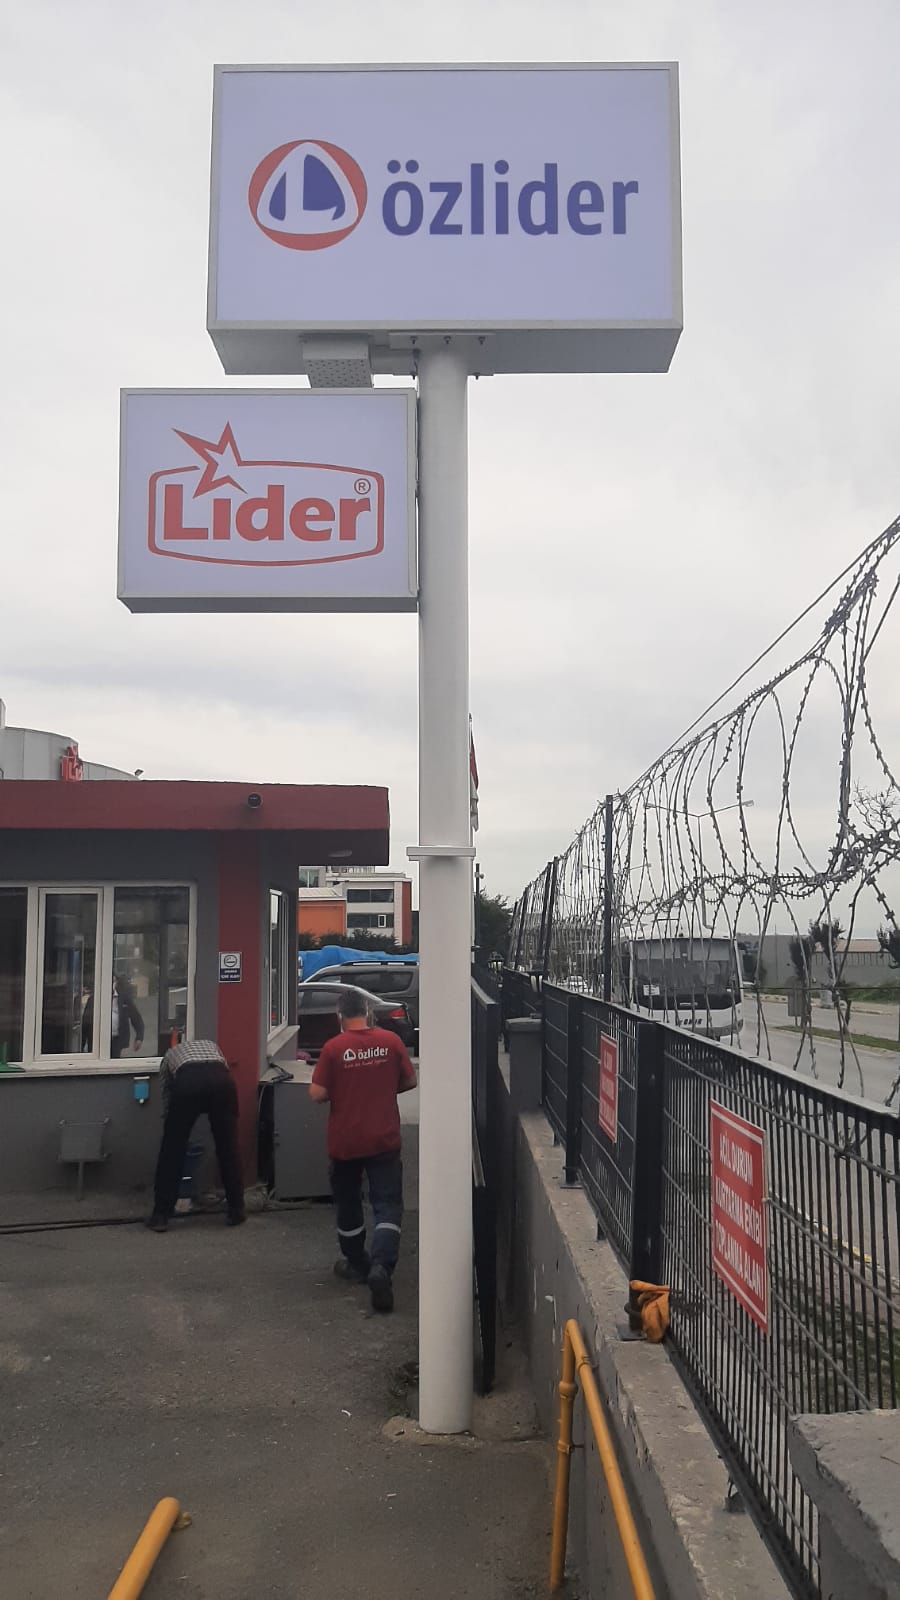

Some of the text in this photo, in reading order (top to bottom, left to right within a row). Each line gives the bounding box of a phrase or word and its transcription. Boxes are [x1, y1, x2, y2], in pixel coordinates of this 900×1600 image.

[381, 159, 639, 236] özlider
[163, 484, 371, 543] Lider
[357, 1046, 389, 1060] özlider
[731, 1147, 754, 1187] DURUM
[744, 1198, 763, 1249] EKİBİ
[743, 1253, 765, 1302] ALANI
